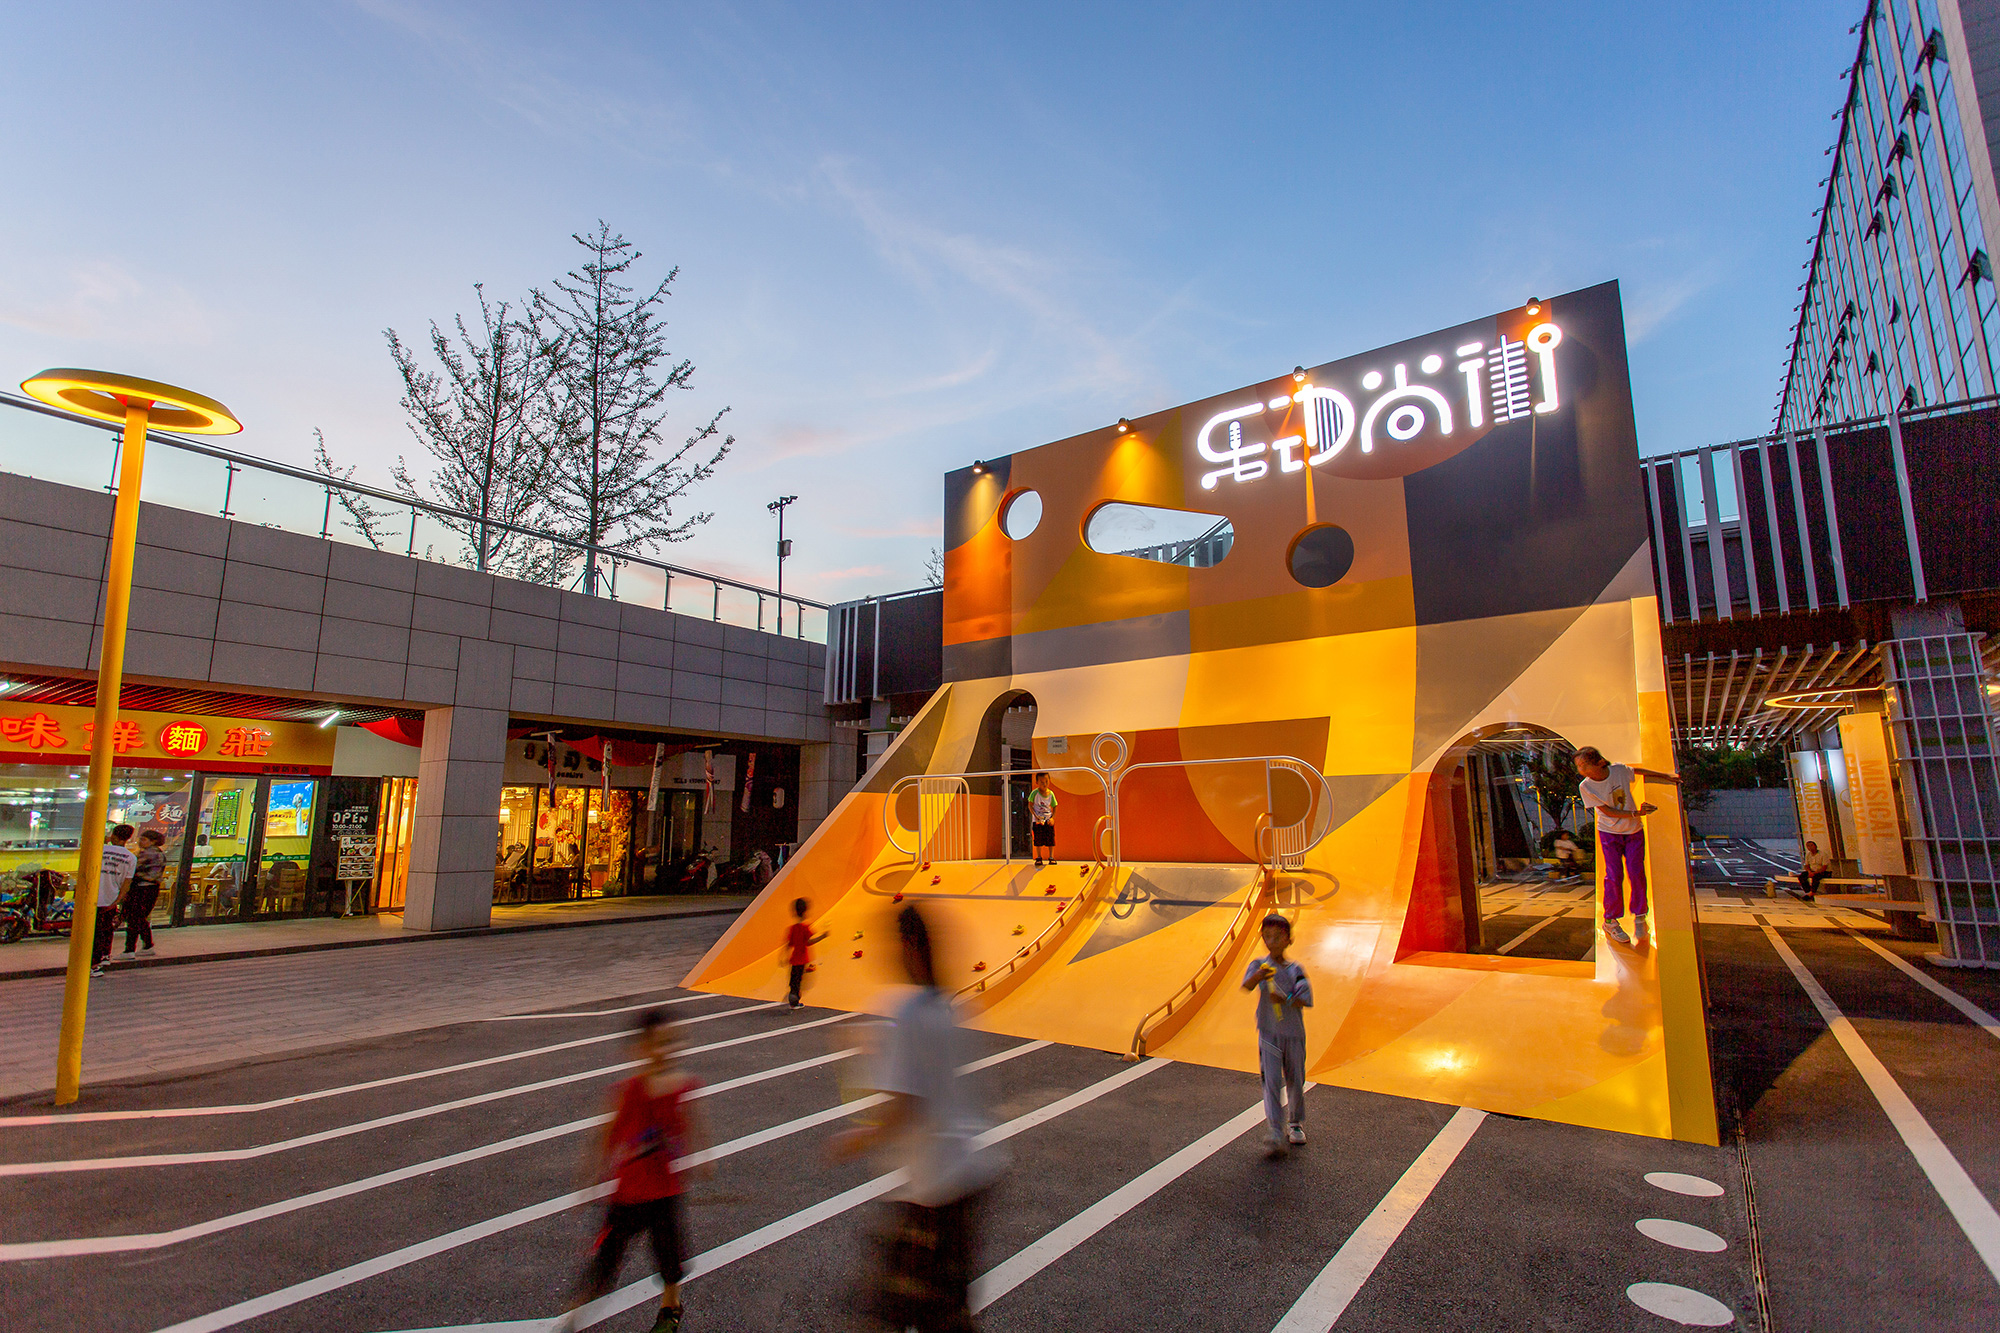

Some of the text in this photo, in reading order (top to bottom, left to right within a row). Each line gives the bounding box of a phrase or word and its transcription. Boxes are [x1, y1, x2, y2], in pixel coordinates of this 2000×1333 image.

[332, 812, 369, 824] OPEN
[1803, 782, 1825, 837] MUSICAL
[1860, 760, 1895, 842] MUSICAL
